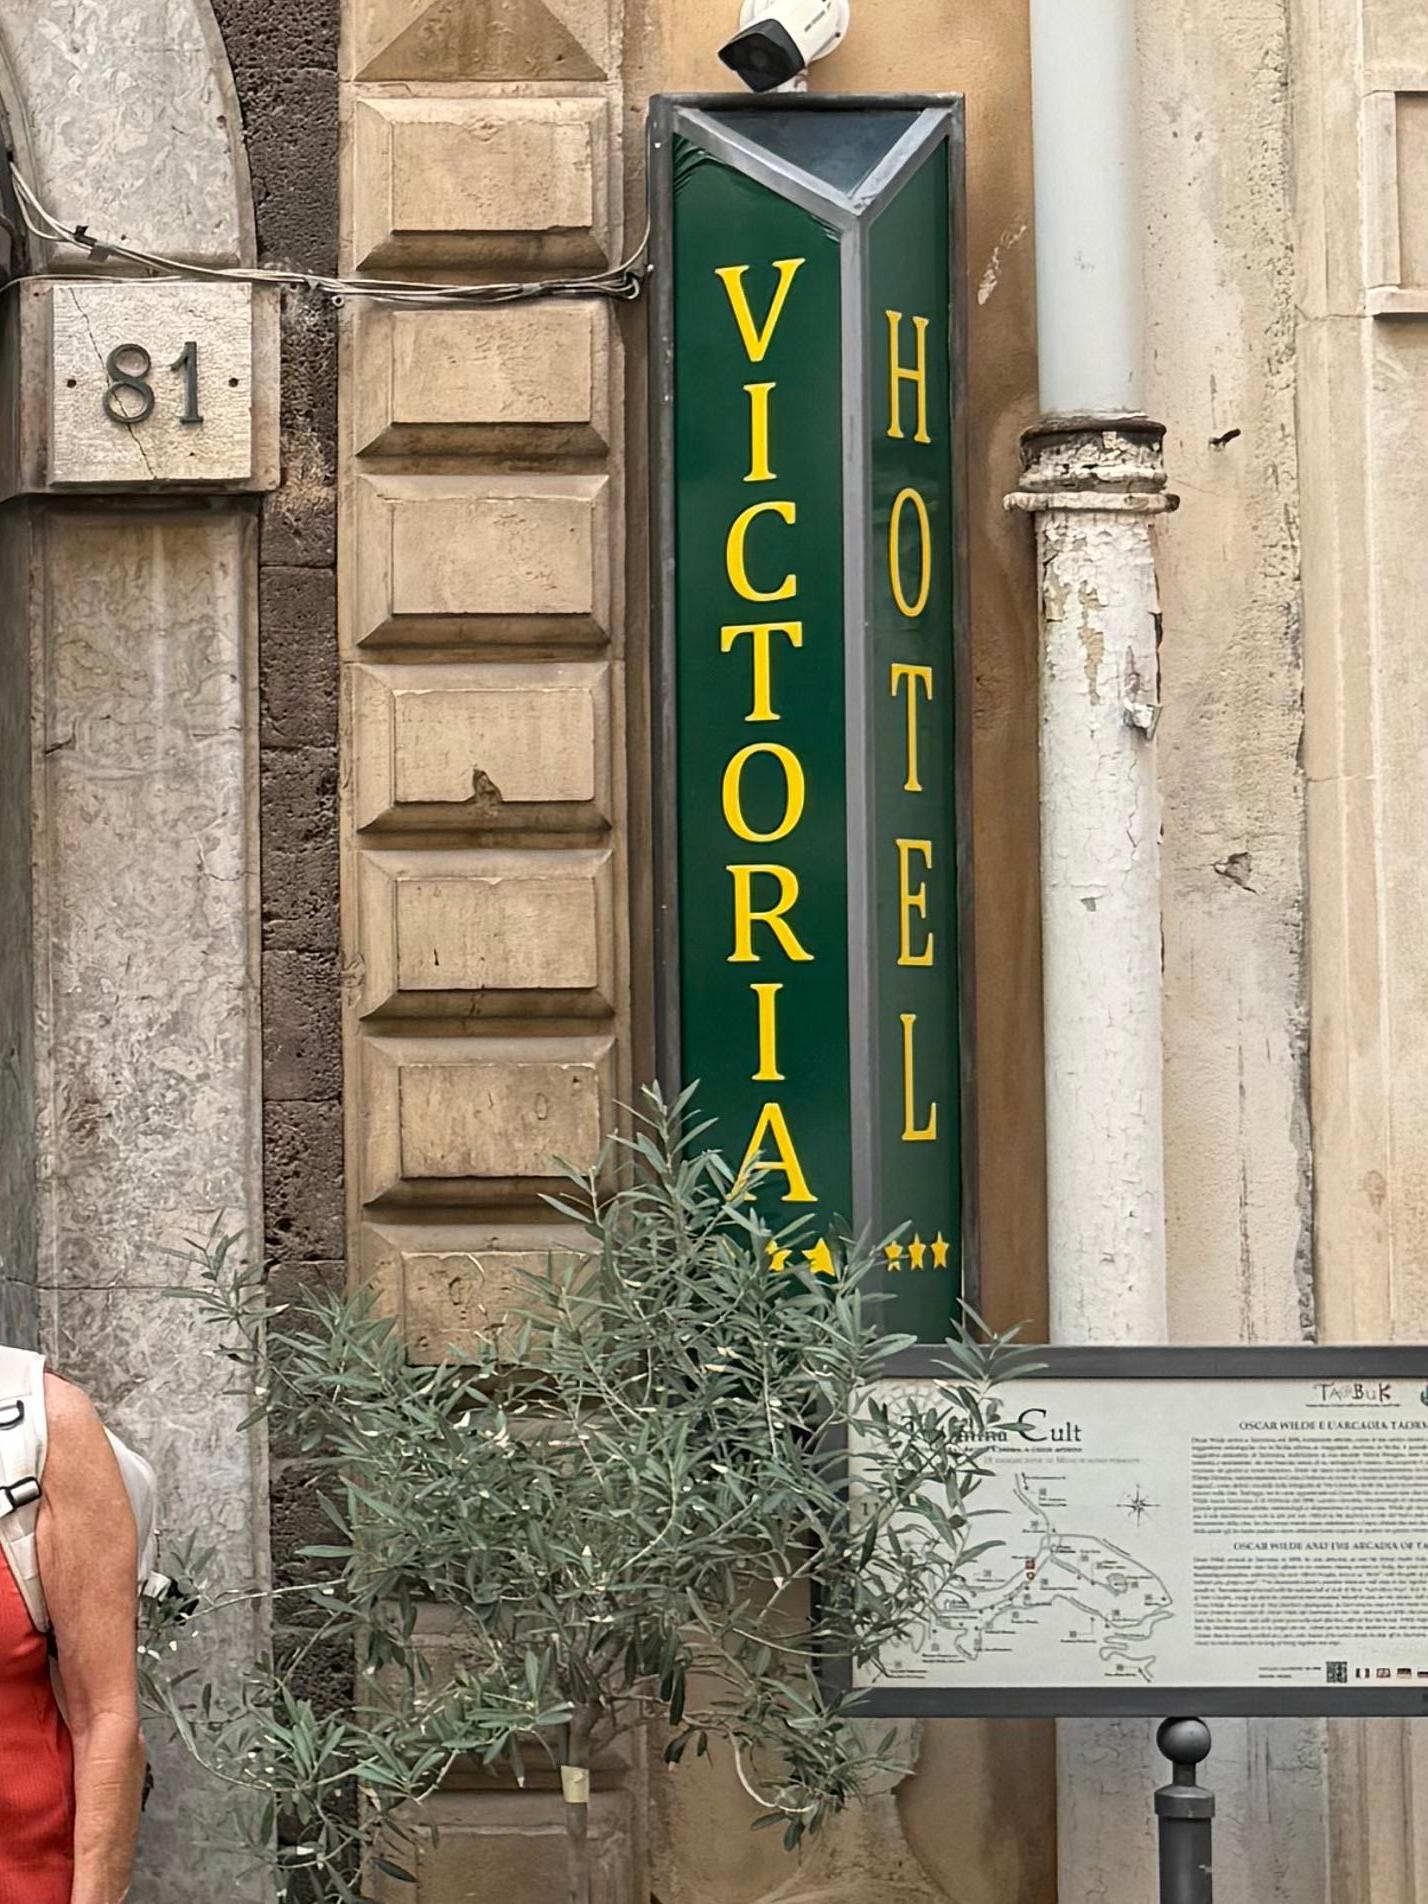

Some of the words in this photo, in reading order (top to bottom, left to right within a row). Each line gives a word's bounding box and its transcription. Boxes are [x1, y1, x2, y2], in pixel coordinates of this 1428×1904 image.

[103, 341, 204, 423] 81
[714, 257, 818, 1202] VICTORIA
[885, 309, 937, 1141] HOTEL
[1018, 1408, 1082, 1442] Cult
[1239, 1421, 1278, 1430] OSCAR
[1279, 1421, 1315, 1430] WILDE
